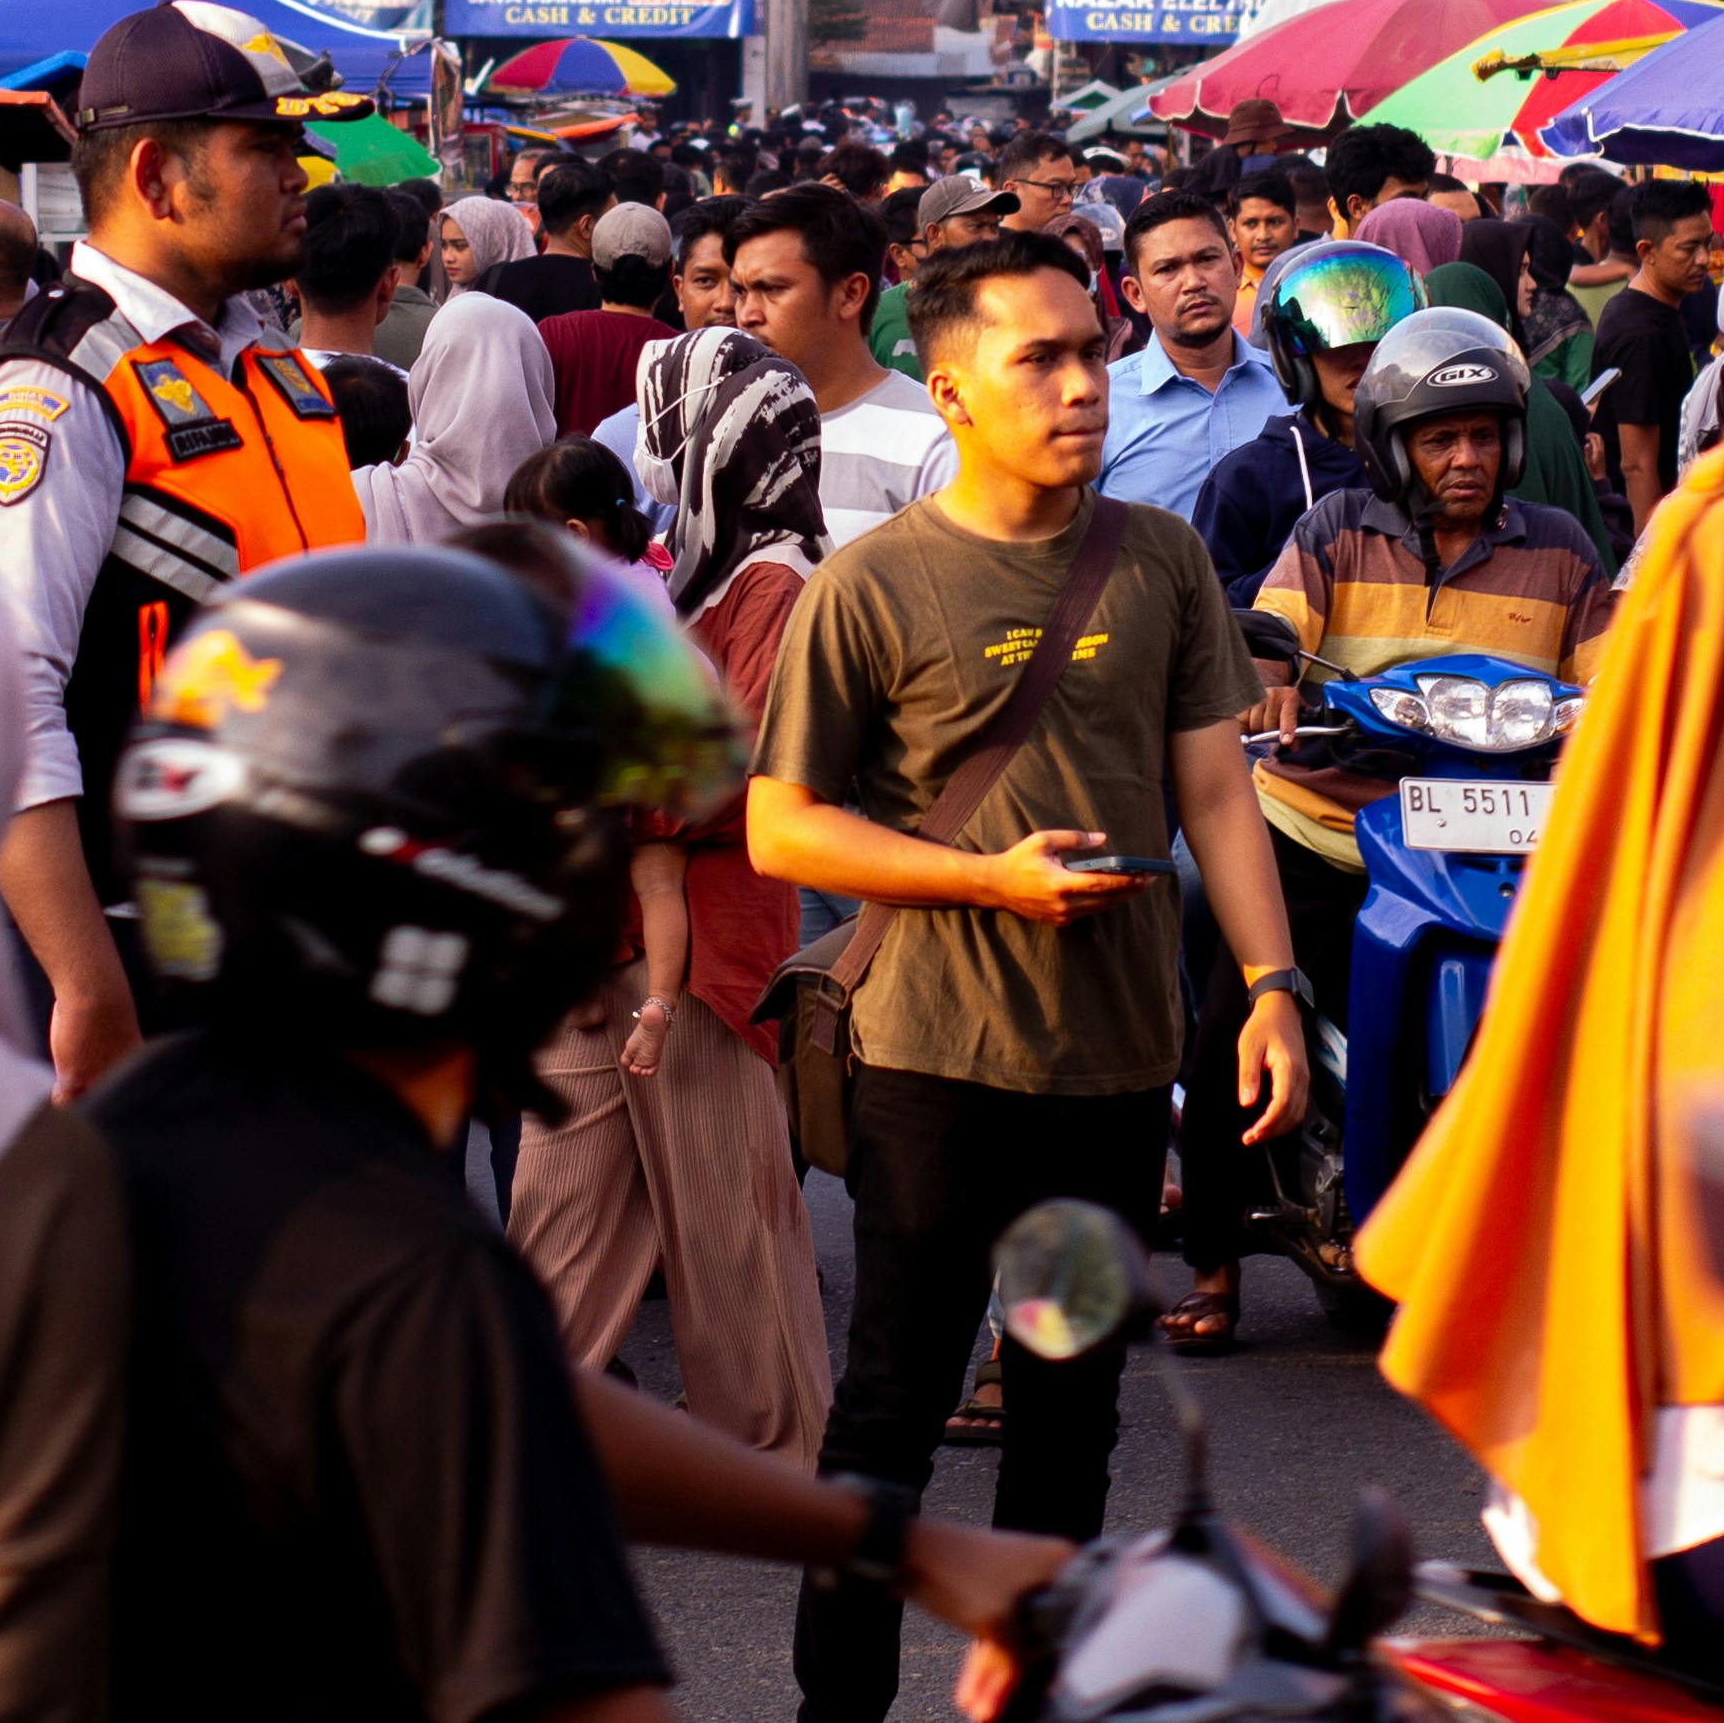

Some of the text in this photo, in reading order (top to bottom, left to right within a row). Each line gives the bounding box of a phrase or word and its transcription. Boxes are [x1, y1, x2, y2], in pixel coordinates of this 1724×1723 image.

[504, 6, 694, 26] CASH & CREDIT
[1086, 12, 1240, 35] CASH & CRE
[984, 640, 1022, 659] SWEET
[1022, 639, 1038, 649] CA
[1409, 785, 1530, 817] BL 5511
